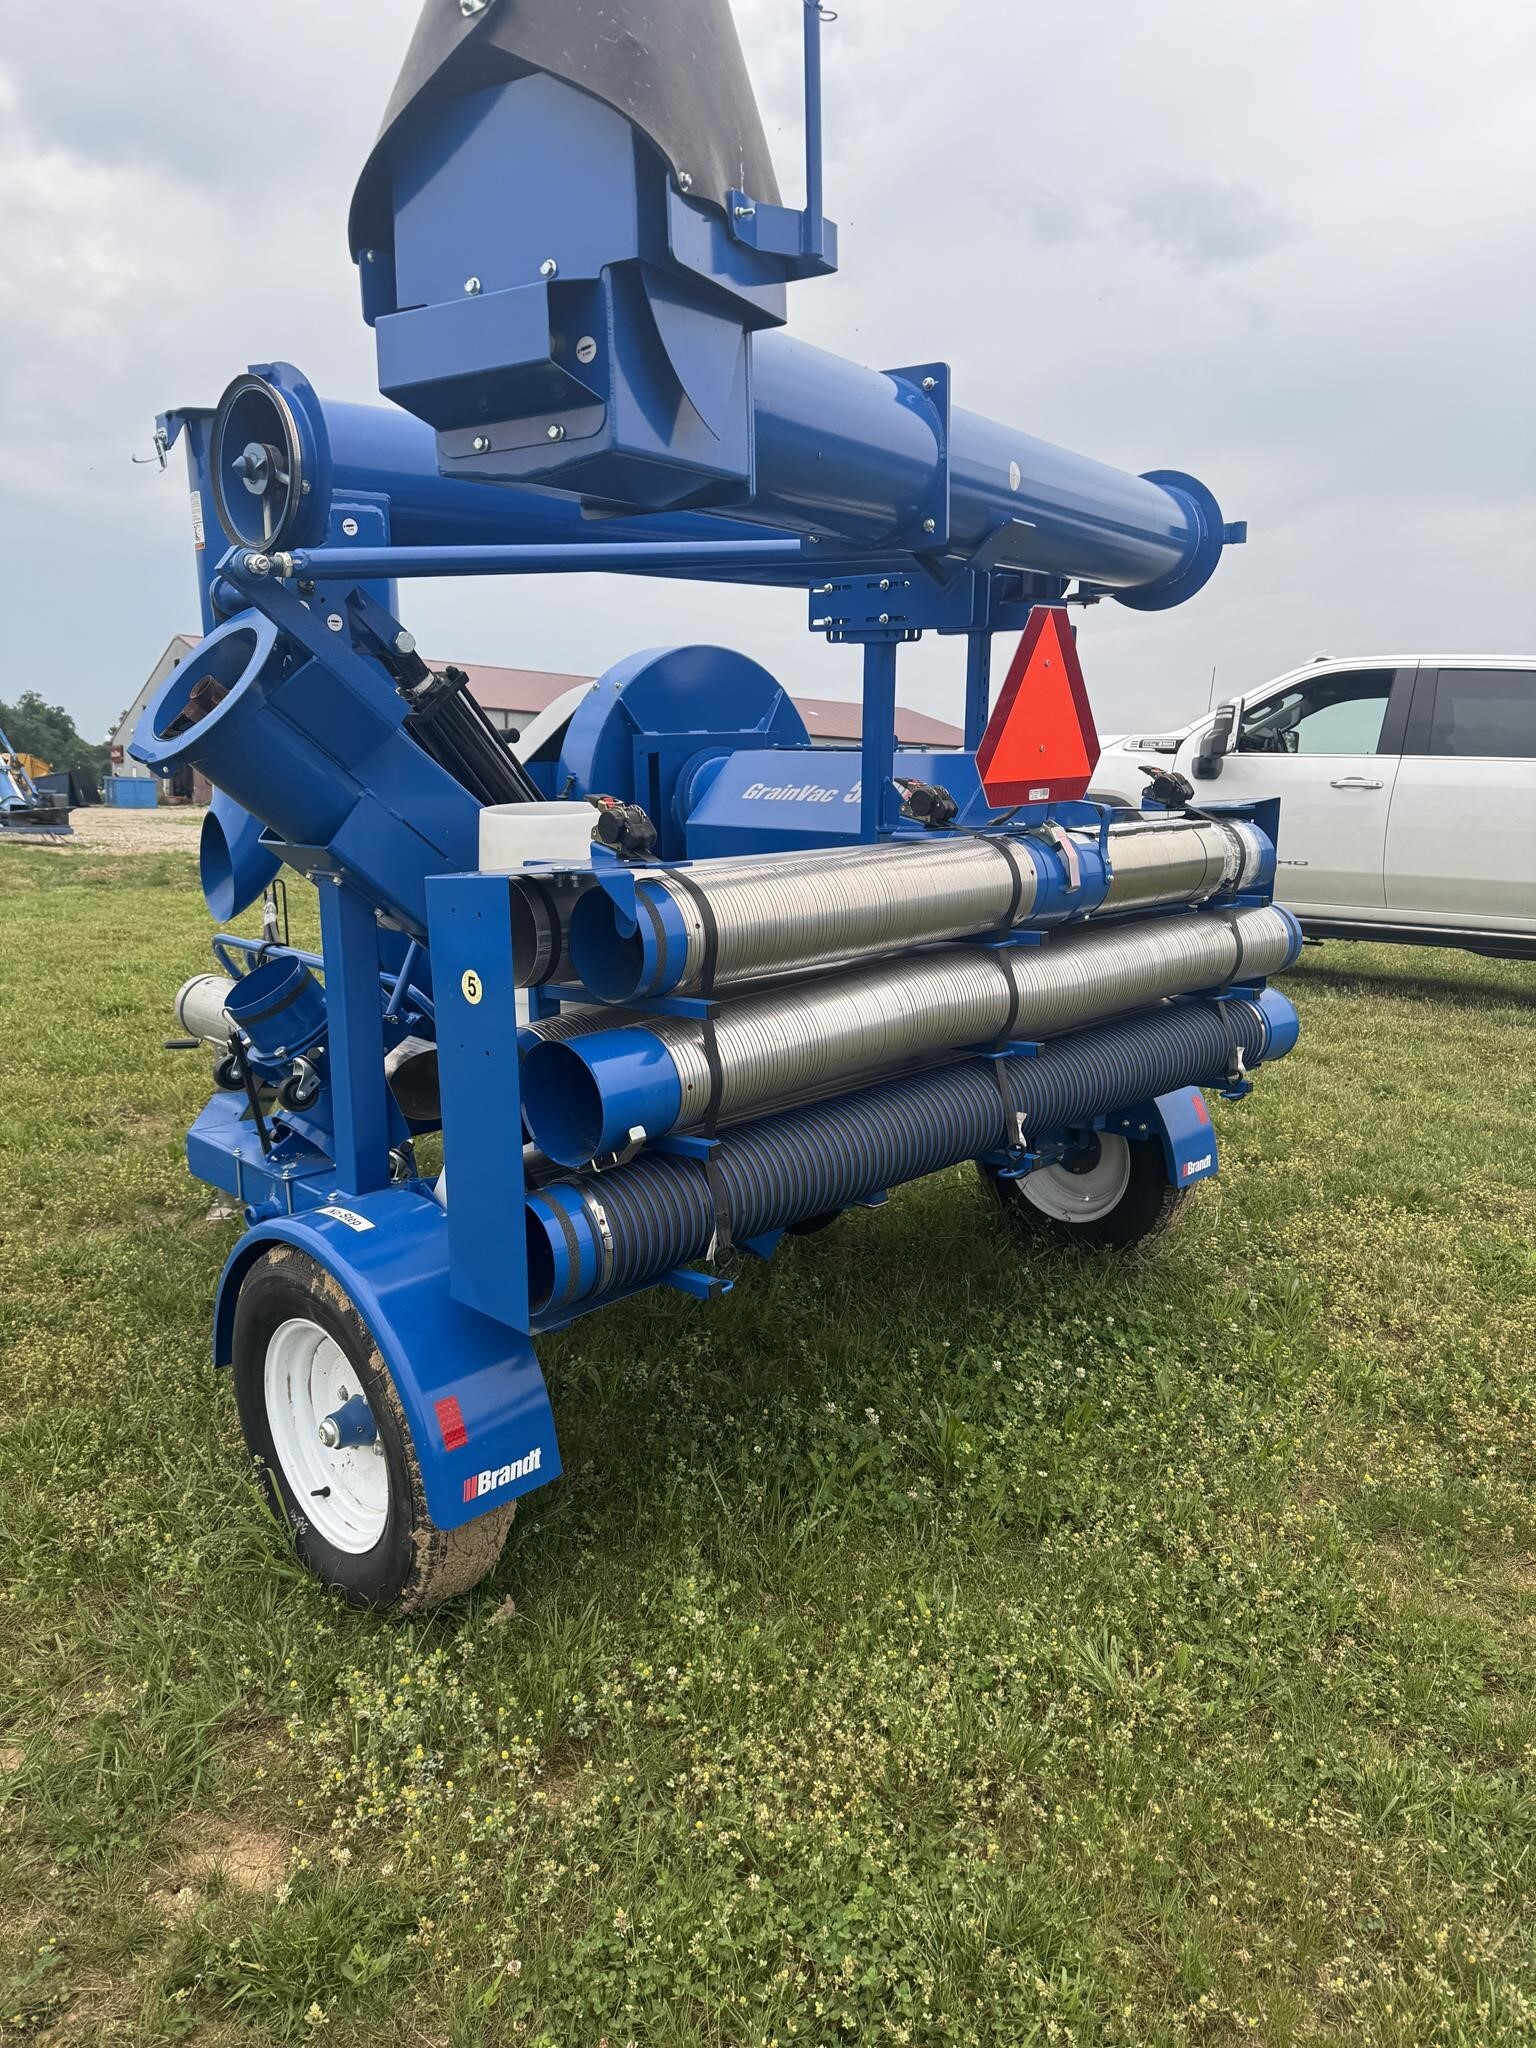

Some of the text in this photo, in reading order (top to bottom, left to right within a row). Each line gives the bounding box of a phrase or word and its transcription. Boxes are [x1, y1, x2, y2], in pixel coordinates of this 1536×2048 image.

[742, 783, 839, 803] GrainVac
[467, 975, 477, 997] 5
[1187, 1154, 1212, 1176] Brandt
[340, 1213, 362, 1226] Step
[477, 1447, 541, 1497] Brandt
